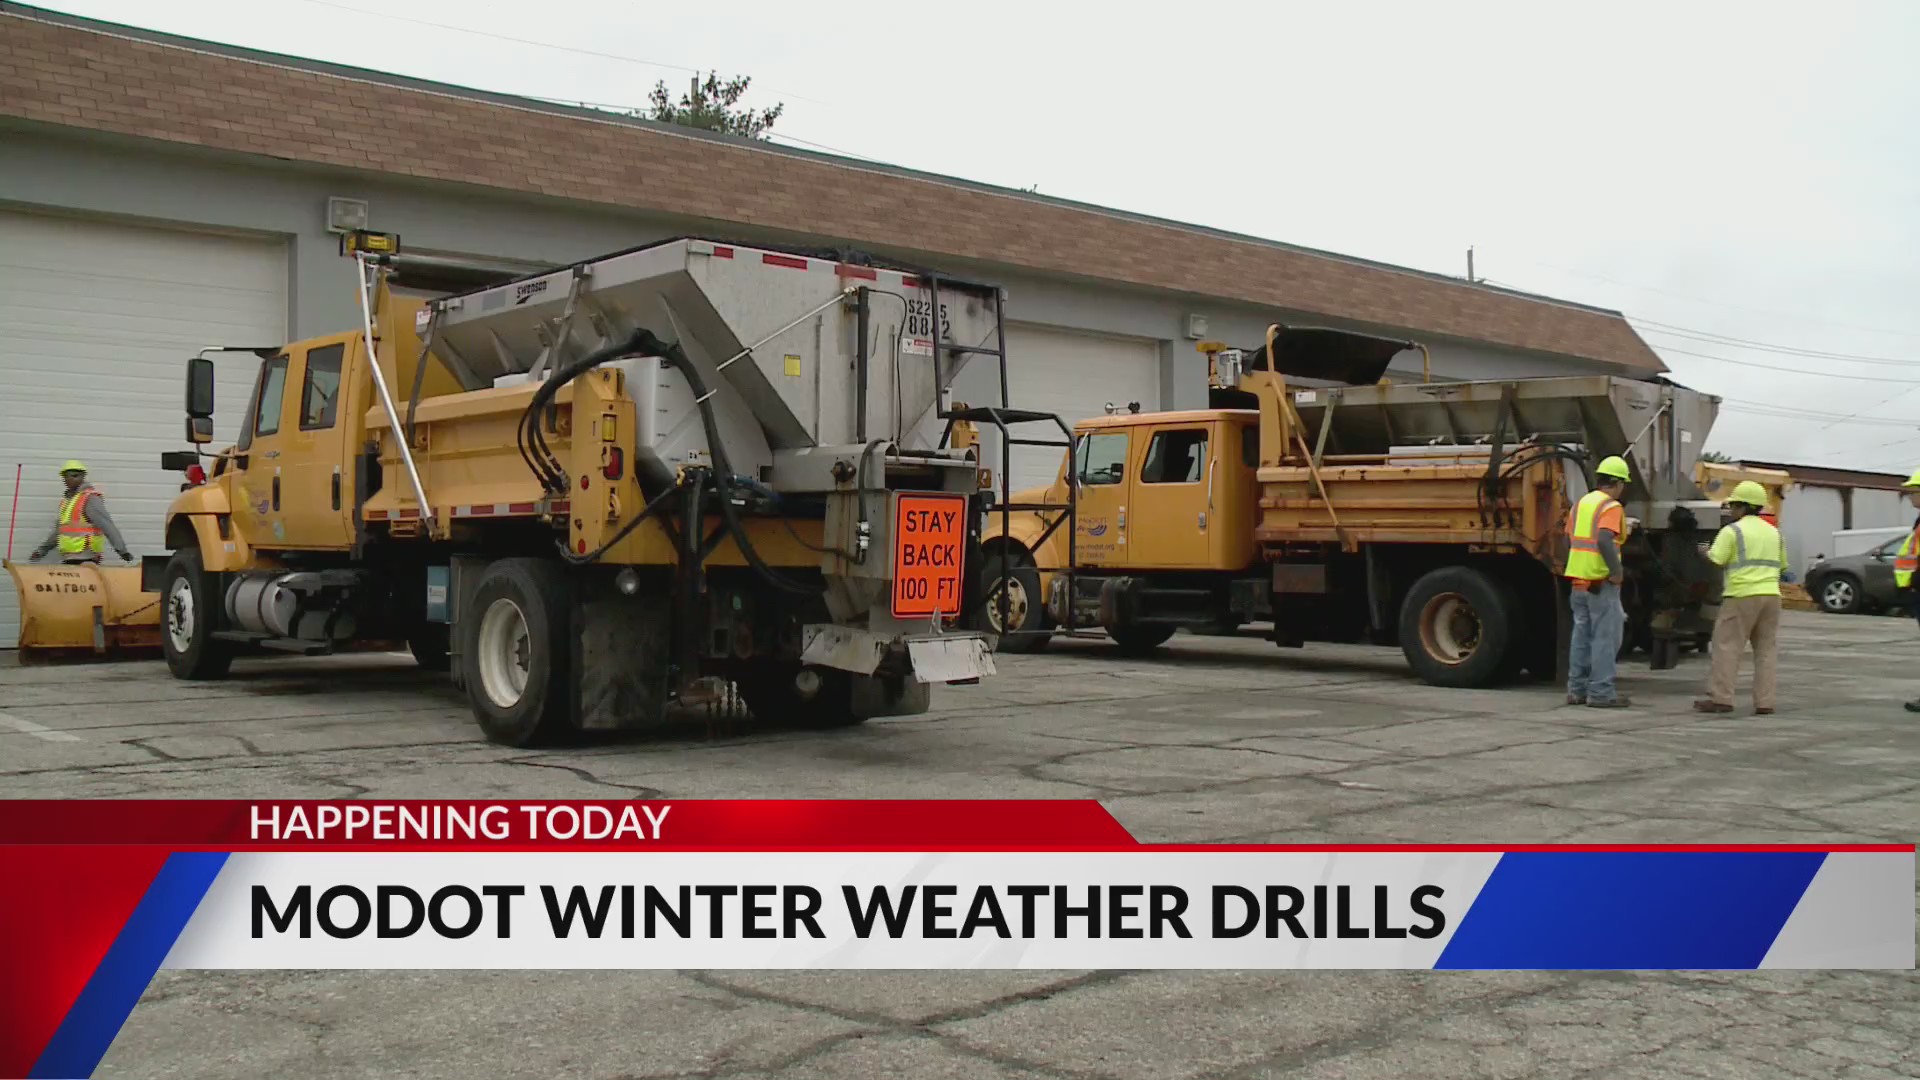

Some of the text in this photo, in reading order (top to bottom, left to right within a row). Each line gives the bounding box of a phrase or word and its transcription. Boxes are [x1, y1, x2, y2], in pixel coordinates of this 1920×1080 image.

[517, 281, 547, 299] SWENSON
[909, 299, 946, 319] S225
[909, 315, 950, 340] 882
[905, 510, 956, 534] STAY
[903, 544, 955, 567] BACK
[901, 577, 956, 600] 100 FT
